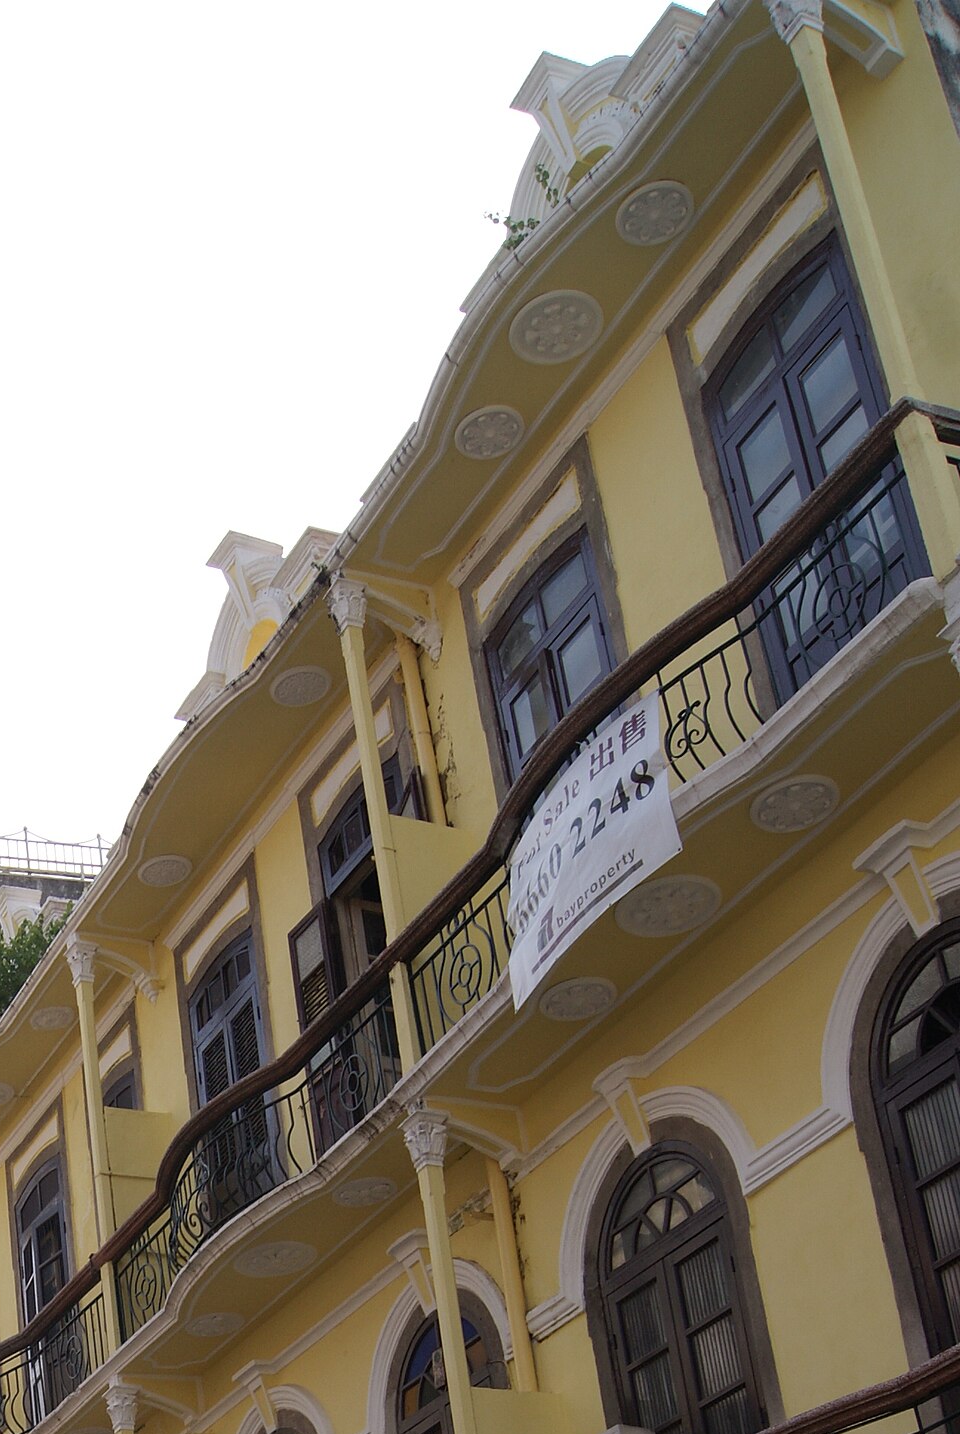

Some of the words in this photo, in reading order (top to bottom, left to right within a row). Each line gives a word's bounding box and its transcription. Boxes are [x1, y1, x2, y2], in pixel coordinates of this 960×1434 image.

[590, 709, 647, 781] 出售
[517, 832, 541, 880] For
[543, 779, 580, 836] Sale
[570, 759, 656, 859] 2248
[556, 848, 636, 928] bayproperty
